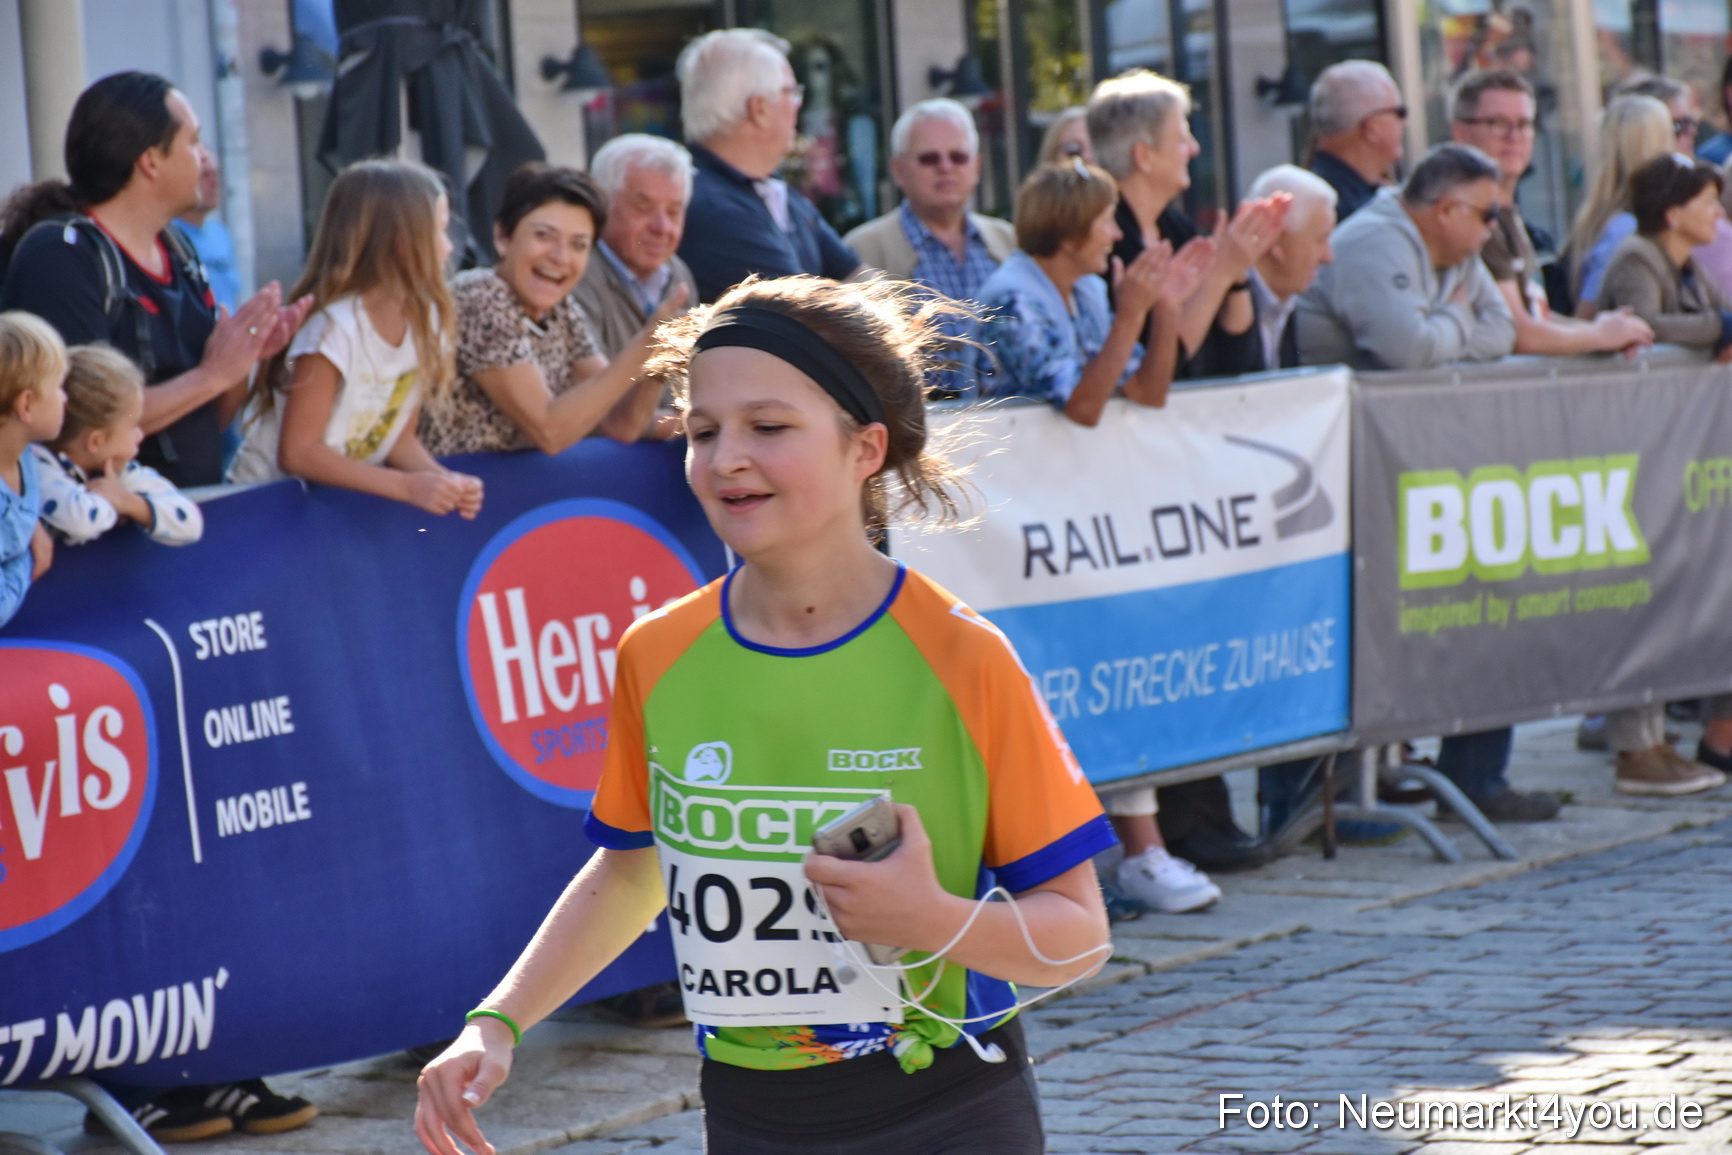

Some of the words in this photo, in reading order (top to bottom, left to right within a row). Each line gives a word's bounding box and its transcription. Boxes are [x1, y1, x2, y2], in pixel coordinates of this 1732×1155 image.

[1021, 493, 1261, 578] RAIL.ONE
[1405, 466, 1639, 575] BOCK
[189, 611, 267, 660] STORE
[477, 575, 683, 724] Her
[1032, 666, 1081, 722] ER
[1087, 643, 1220, 716] STRECKE
[1223, 617, 1338, 691] ZUHAUSE
[204, 696, 295, 749] ONLINE
[531, 716, 609, 765] SPORTS
[829, 748, 922, 771] BOCK
[216, 782, 312, 838] MOBILE
[681, 963, 841, 998] CAROLA
[38, 967, 230, 1080] MOVIN'
